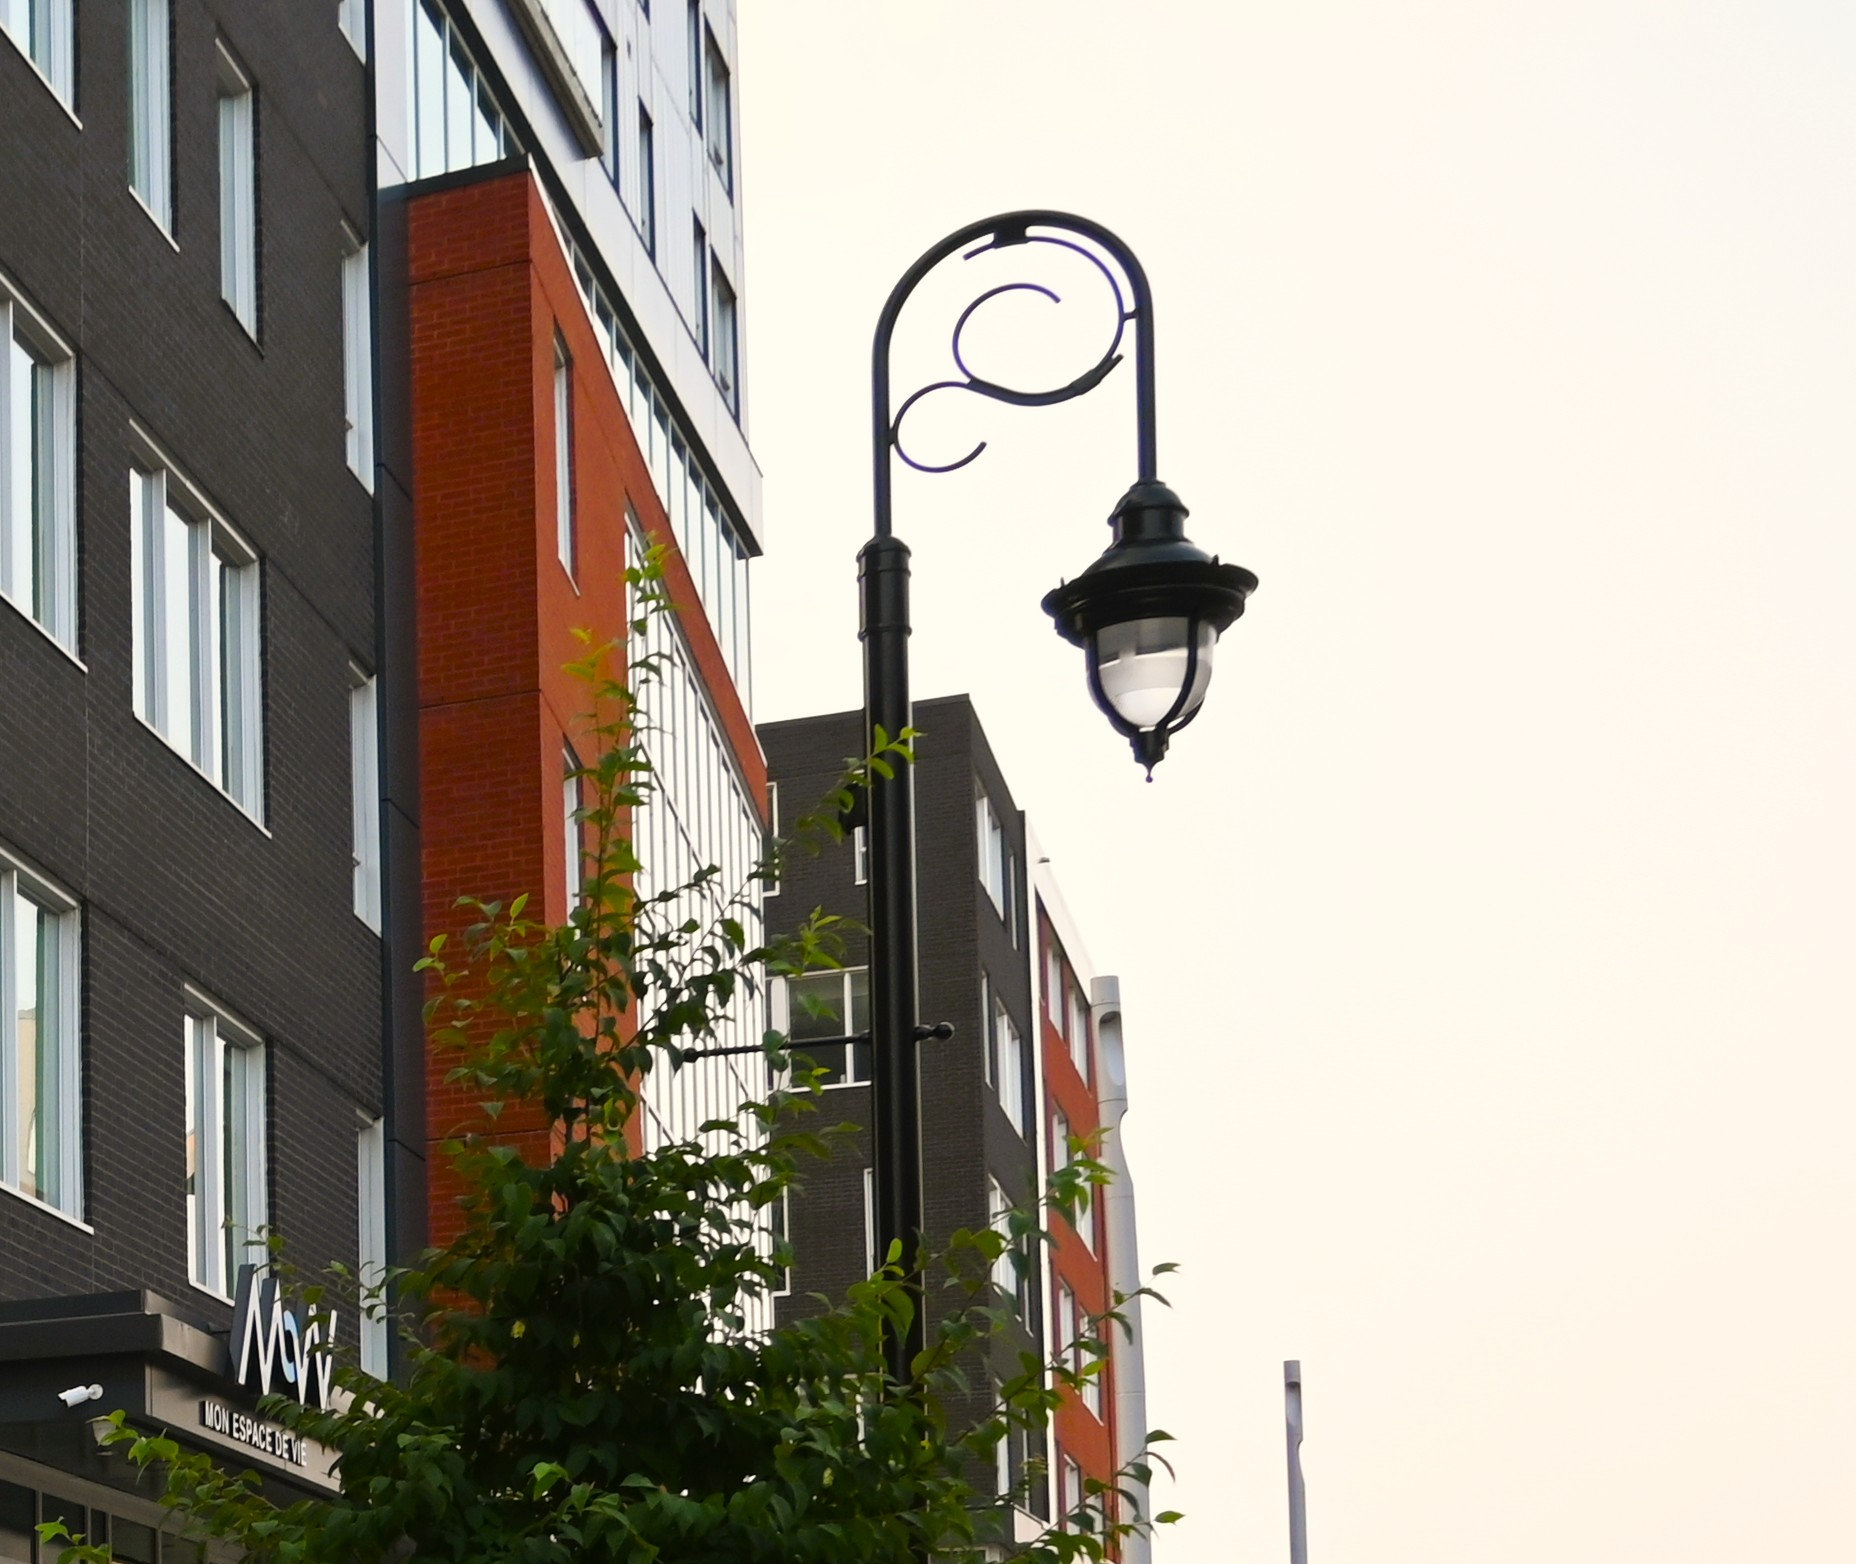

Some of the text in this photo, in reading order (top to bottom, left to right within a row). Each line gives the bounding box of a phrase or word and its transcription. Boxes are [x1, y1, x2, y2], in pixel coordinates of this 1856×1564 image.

[205, 1400, 308, 1467] MON ESPACE DE VIE
